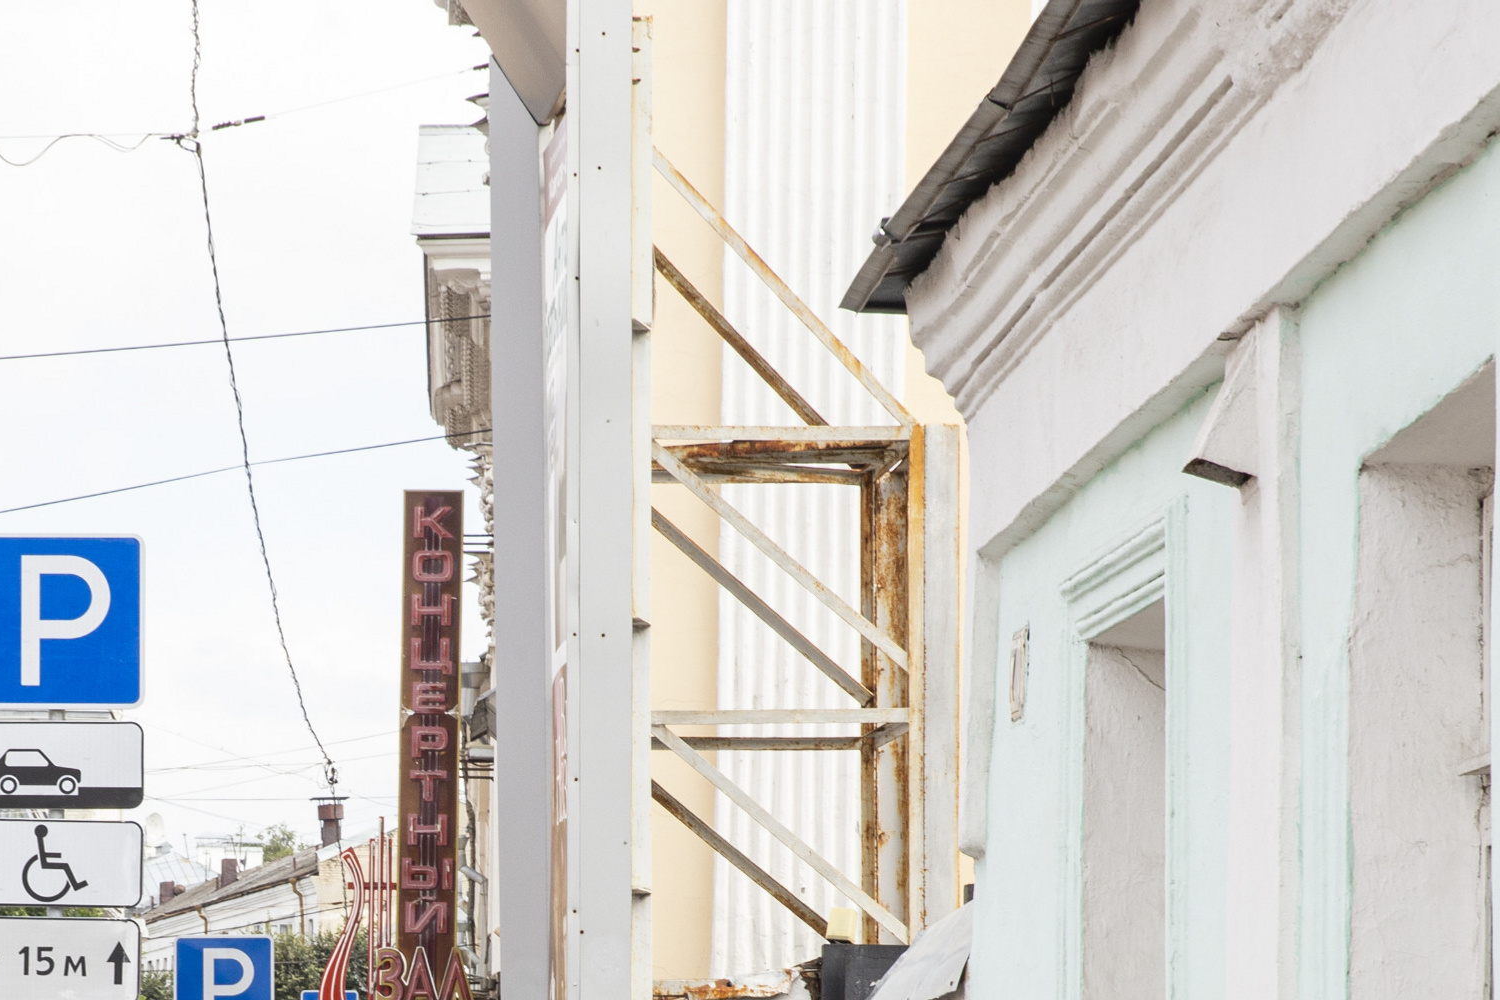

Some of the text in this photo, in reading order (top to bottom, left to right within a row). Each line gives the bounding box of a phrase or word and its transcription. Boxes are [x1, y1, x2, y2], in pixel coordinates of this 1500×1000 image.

[20, 555, 111, 686] P
[402, 506, 454, 934] КОНЦЕРТНЫЙ
[18, 946, 55, 976] 15
